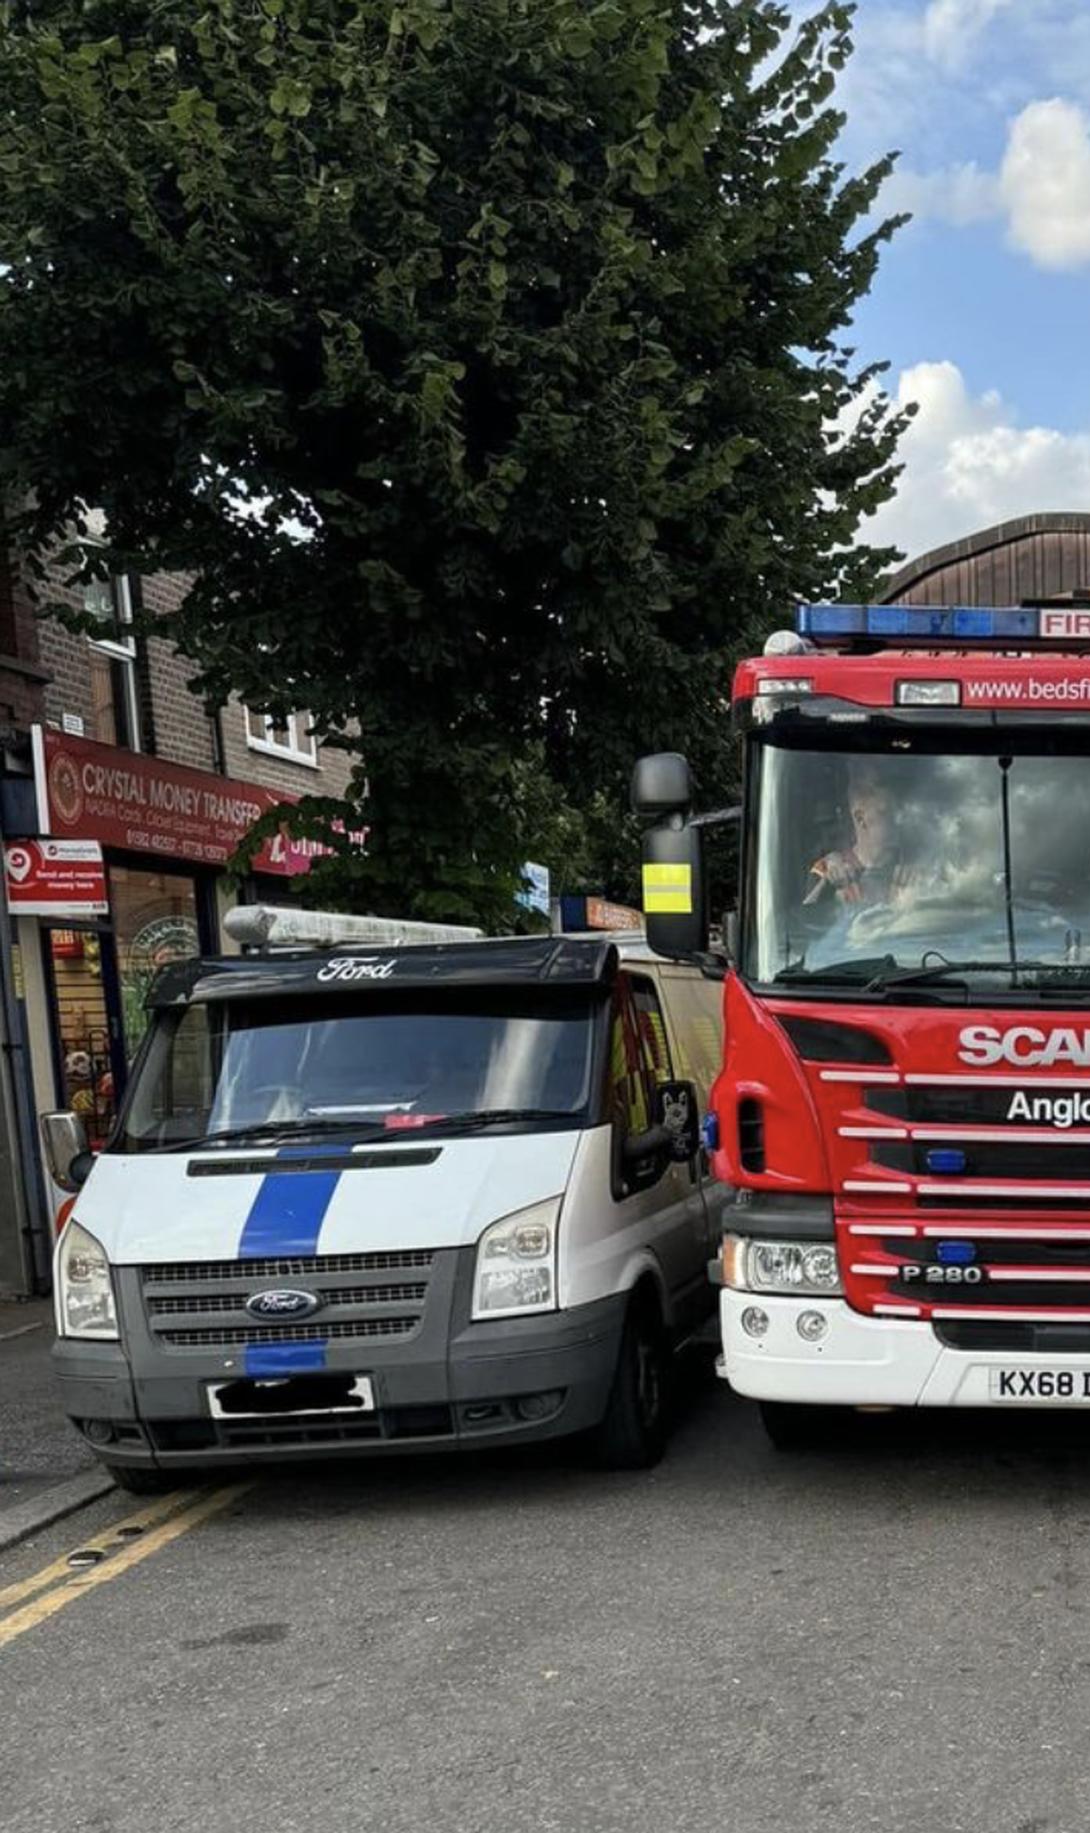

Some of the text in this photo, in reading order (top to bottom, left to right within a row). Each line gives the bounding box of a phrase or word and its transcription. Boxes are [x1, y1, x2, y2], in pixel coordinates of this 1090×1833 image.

[82, 763, 147, 805] CRYSTAL
[149, 779, 201, 816] MONEY
[317, 956, 398, 981] Ford
[903, 1266, 983, 1283] P 280
[260, 1293, 299, 1312] Ford
[999, 1371, 1074, 1396] KX68
